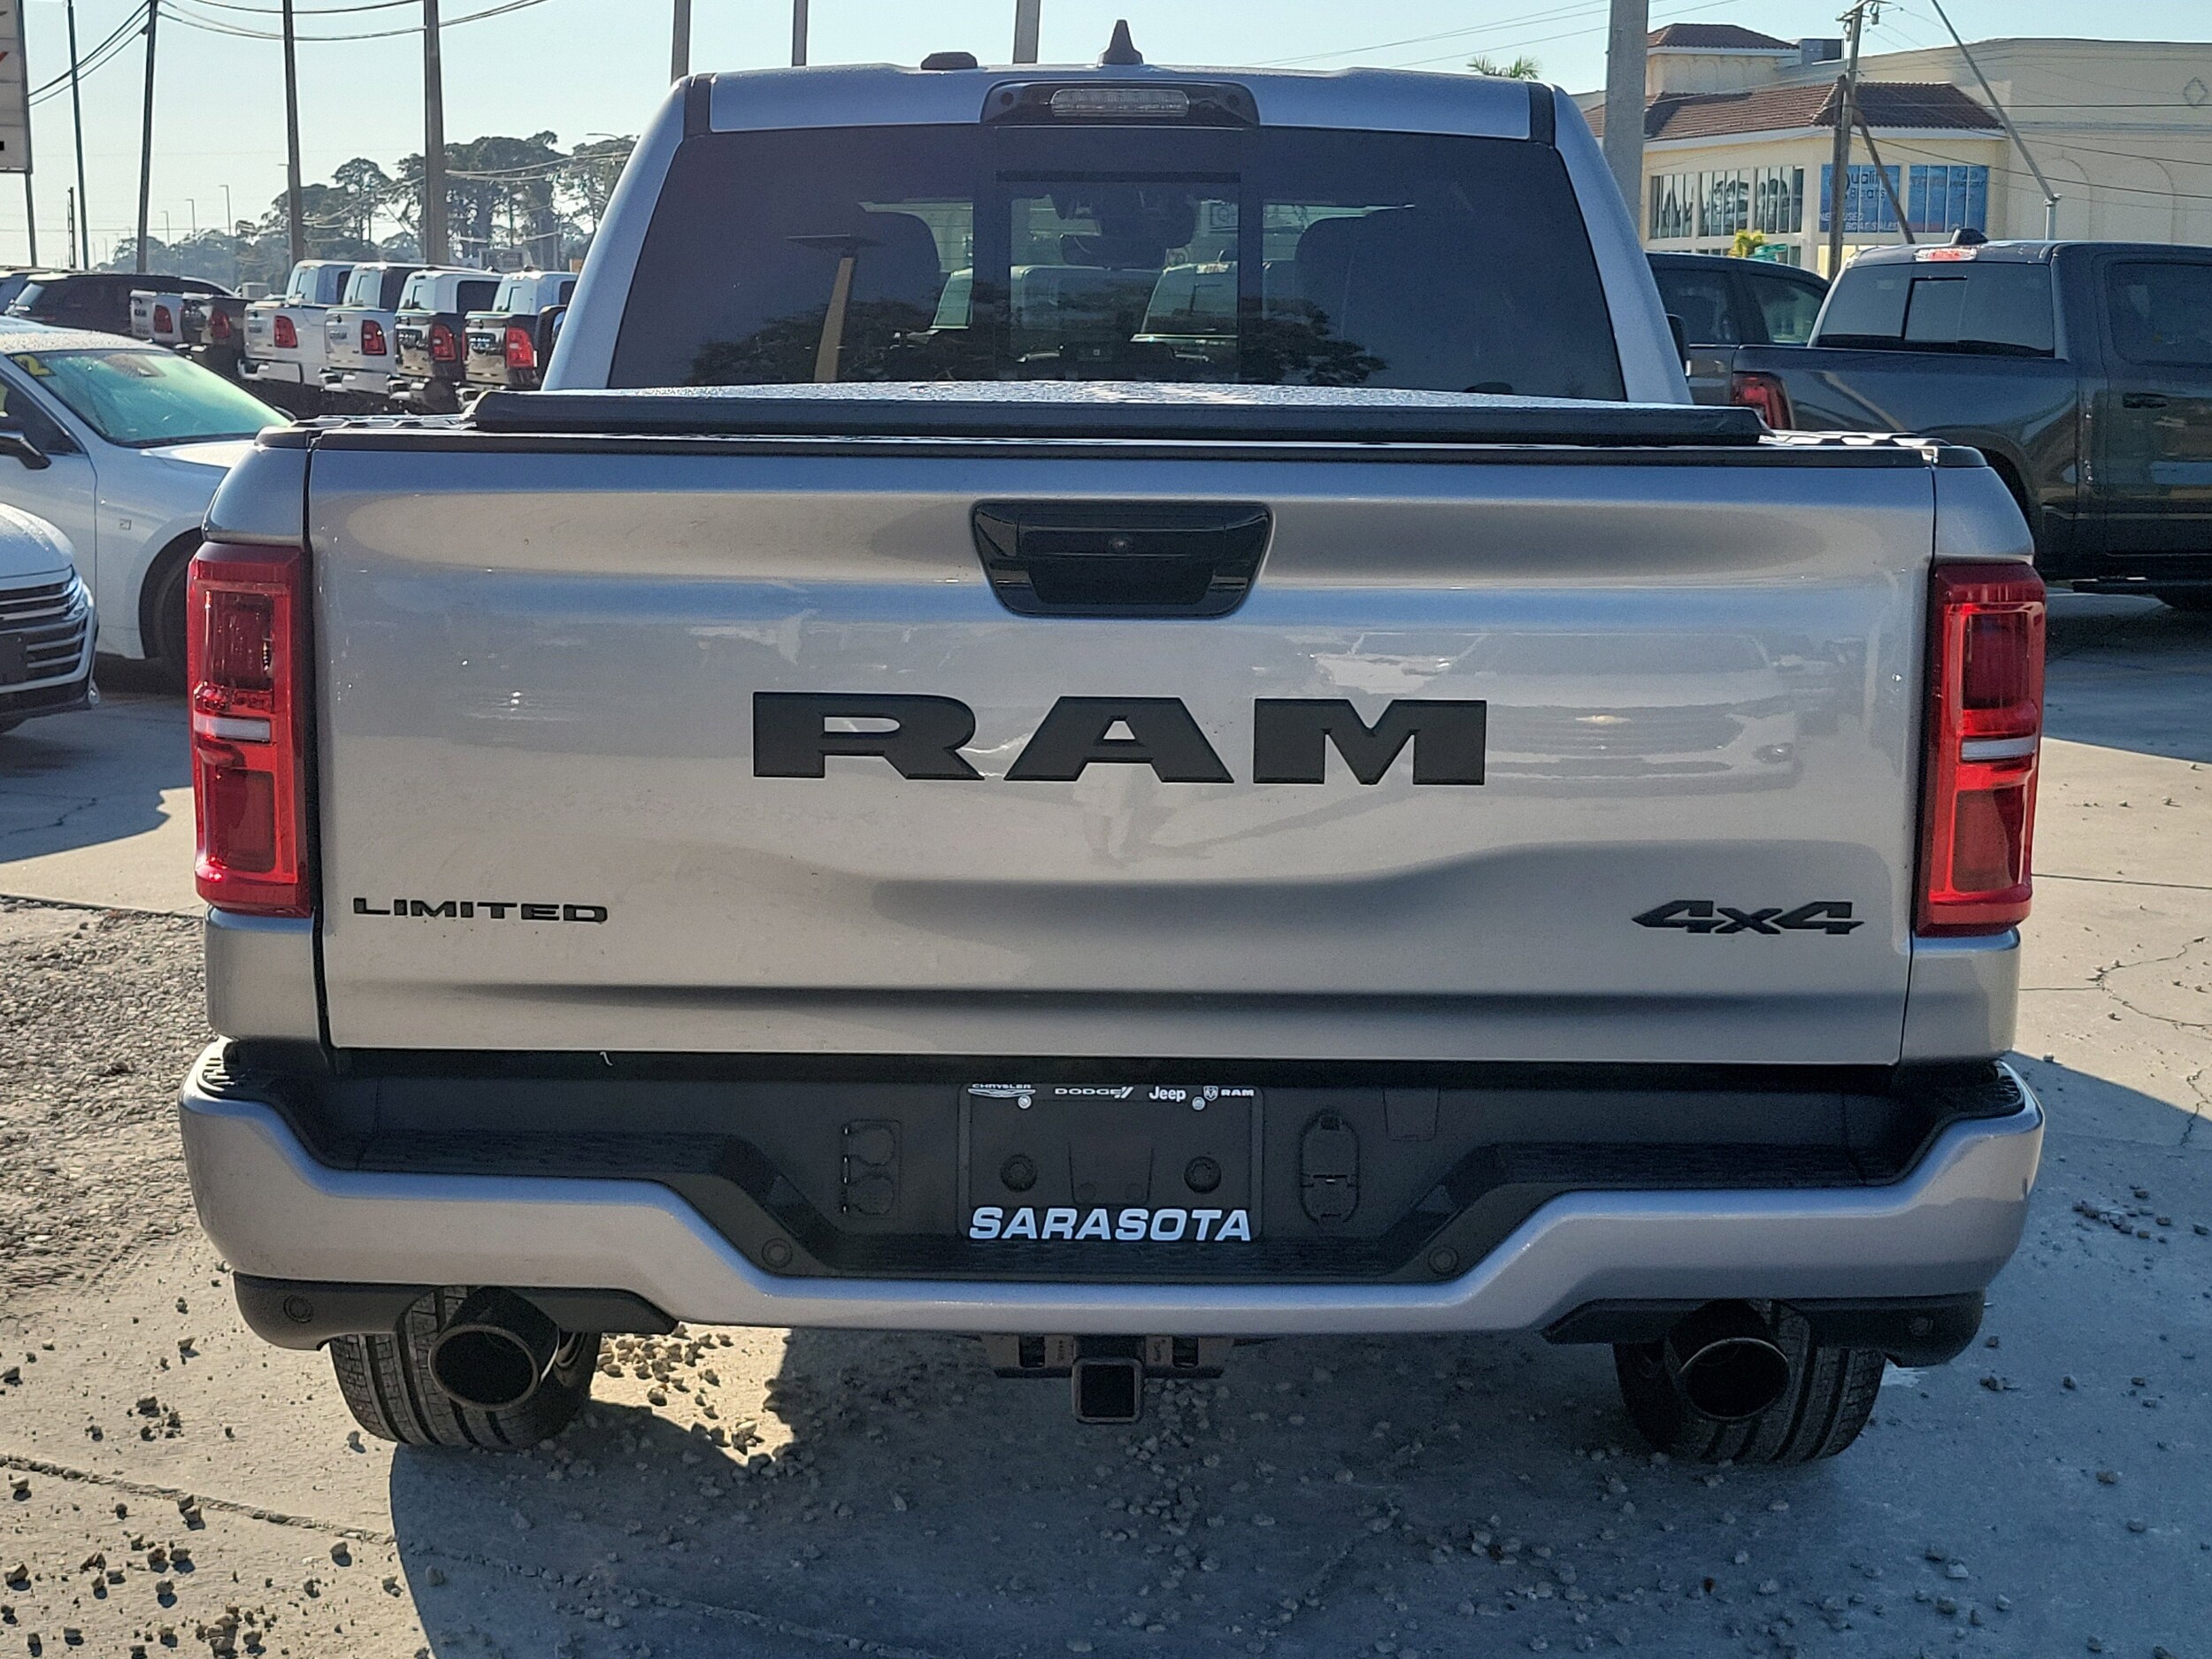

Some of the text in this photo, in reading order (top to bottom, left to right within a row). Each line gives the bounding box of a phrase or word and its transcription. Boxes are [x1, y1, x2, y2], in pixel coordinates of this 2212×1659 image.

[753, 691, 1487, 786] RAM
[353, 897, 608, 923] LIMITED
[1632, 899, 1864, 935] 4x4
[1054, 1087, 1122, 1096] DODGE
[1148, 1086, 1187, 1102] Jeep
[969, 1207, 1251, 1241] SARASOTA
